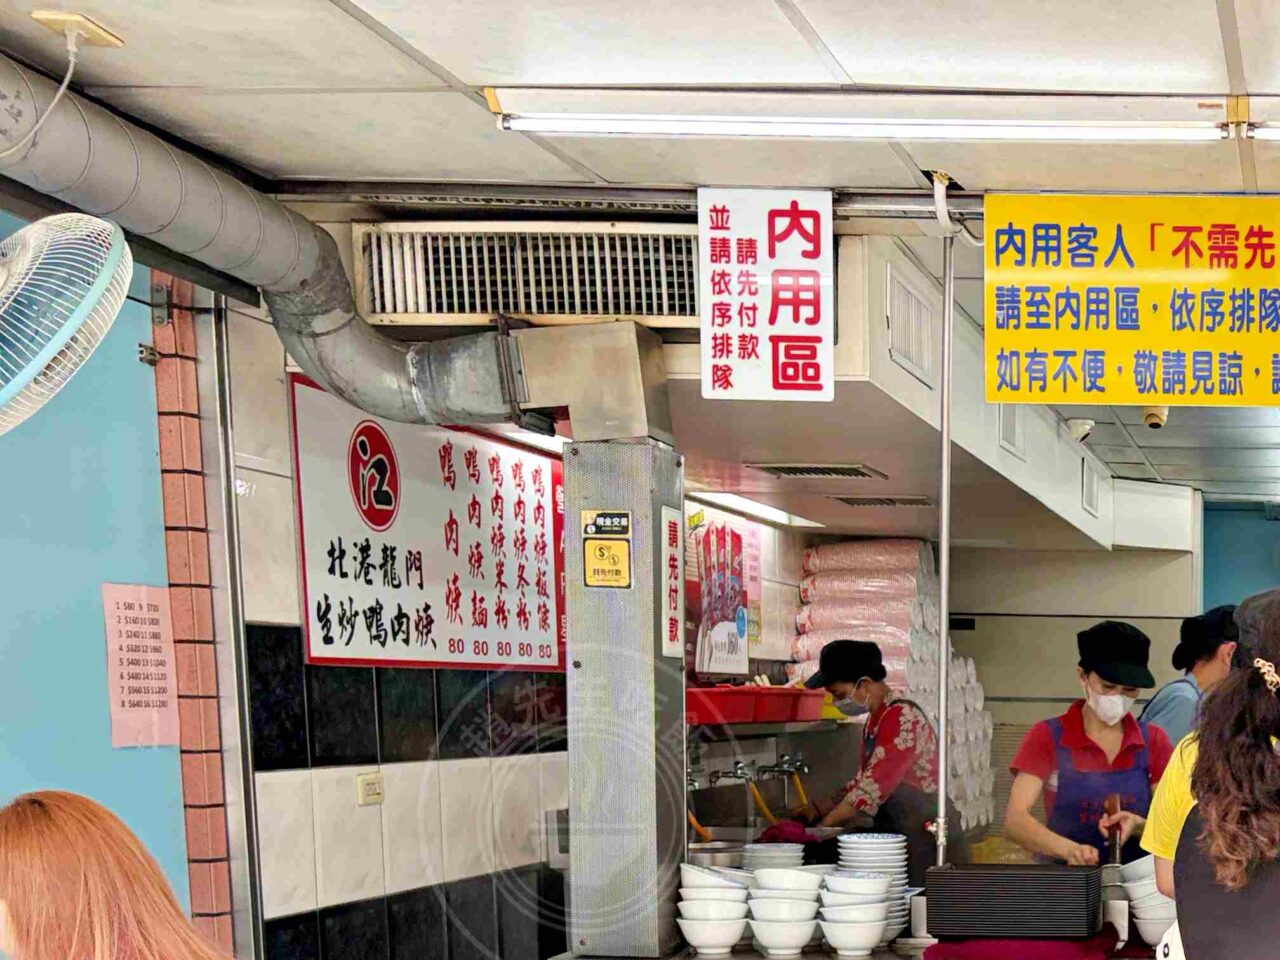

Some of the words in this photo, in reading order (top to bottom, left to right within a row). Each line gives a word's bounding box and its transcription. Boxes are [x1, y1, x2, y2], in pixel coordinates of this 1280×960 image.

[708, 205, 734, 391] 並請依序排隊
[735, 236, 760, 361] 請先付款
[766, 198, 825, 392] 內用區
[327, 536, 425, 591] 北港龍門
[667, 519, 680, 643] 請先付款
[448, 638, 465, 654] 80
[473, 640, 488, 655] 80
[497, 641, 512, 656] 80
[518, 642, 533, 657] 80
[538, 644, 552, 659] 80
